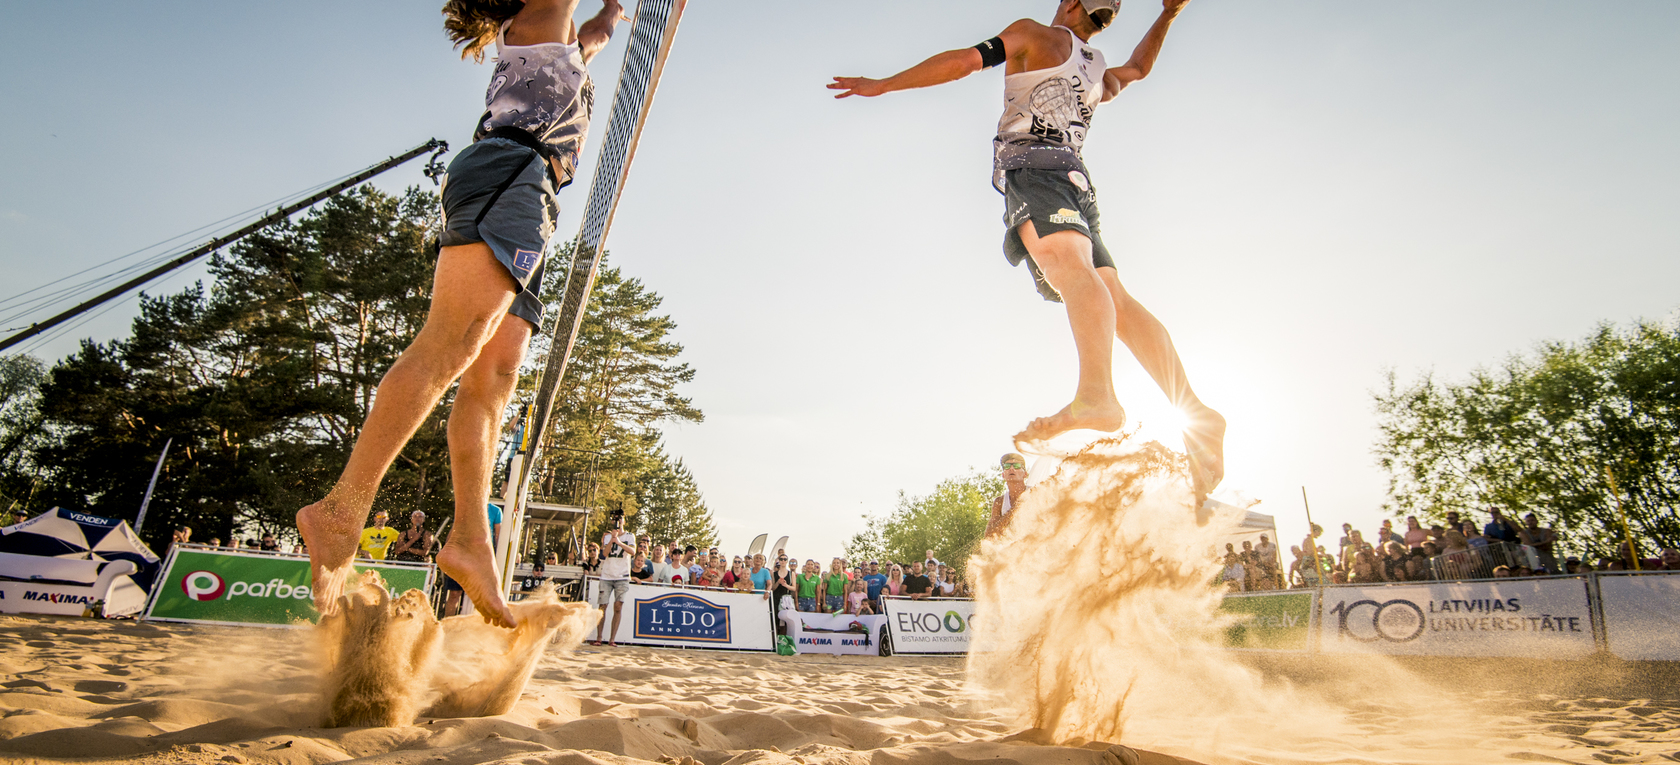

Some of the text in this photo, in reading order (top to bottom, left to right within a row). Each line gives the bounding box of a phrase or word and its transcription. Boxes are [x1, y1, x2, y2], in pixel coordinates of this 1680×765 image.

[70, 512, 109, 525] VENDEN
[22, 590, 88, 604] MAXIMA
[1429, 598, 1521, 616] LATVIJAS
[651, 608, 716, 628] LIDO
[897, 612, 941, 633] EKO
[1431, 614, 1582, 632] UNIVERSITĀTE
[799, 637, 832, 646] MAXIMA
